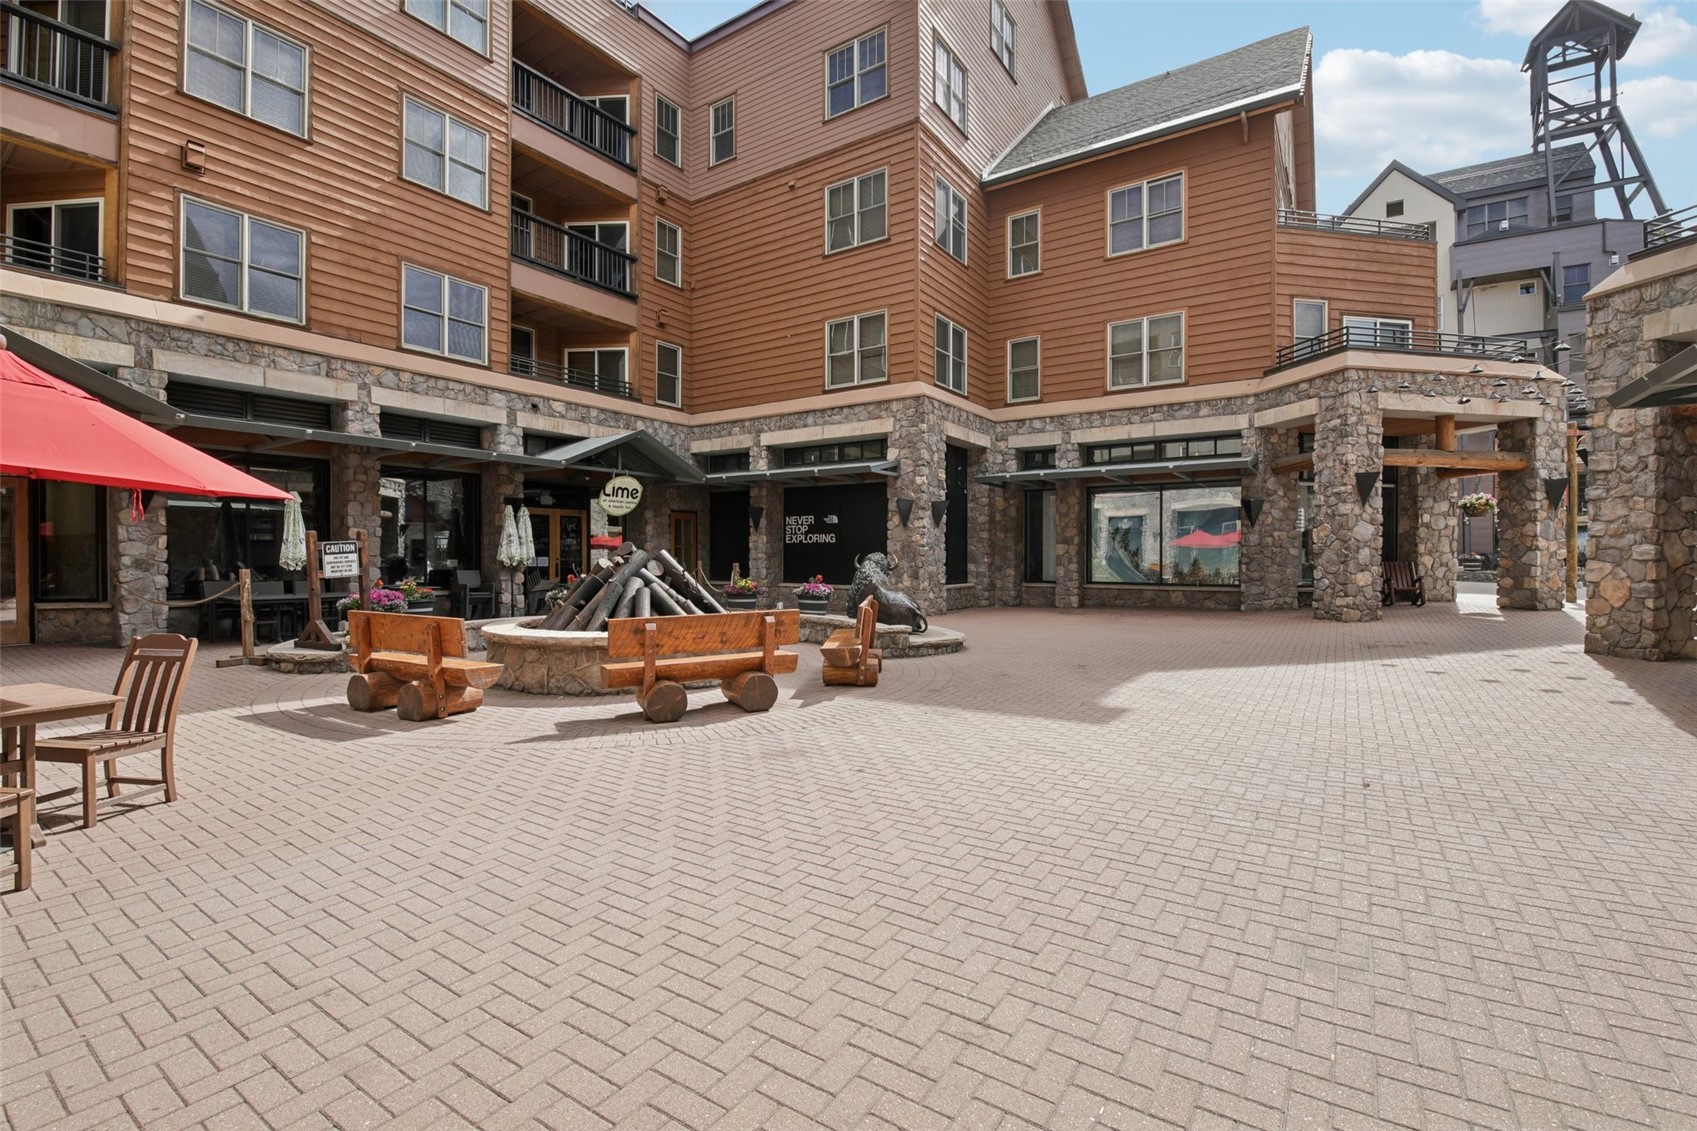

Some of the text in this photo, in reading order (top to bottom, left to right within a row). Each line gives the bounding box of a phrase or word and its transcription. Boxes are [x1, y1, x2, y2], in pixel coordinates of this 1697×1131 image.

[603, 483, 639, 499] Lime
[785, 515, 815, 525] NEVER
[785, 525, 808, 534] STOP
[785, 533, 836, 543] EXPLORING
[326, 544, 355, 553] CAUTION
